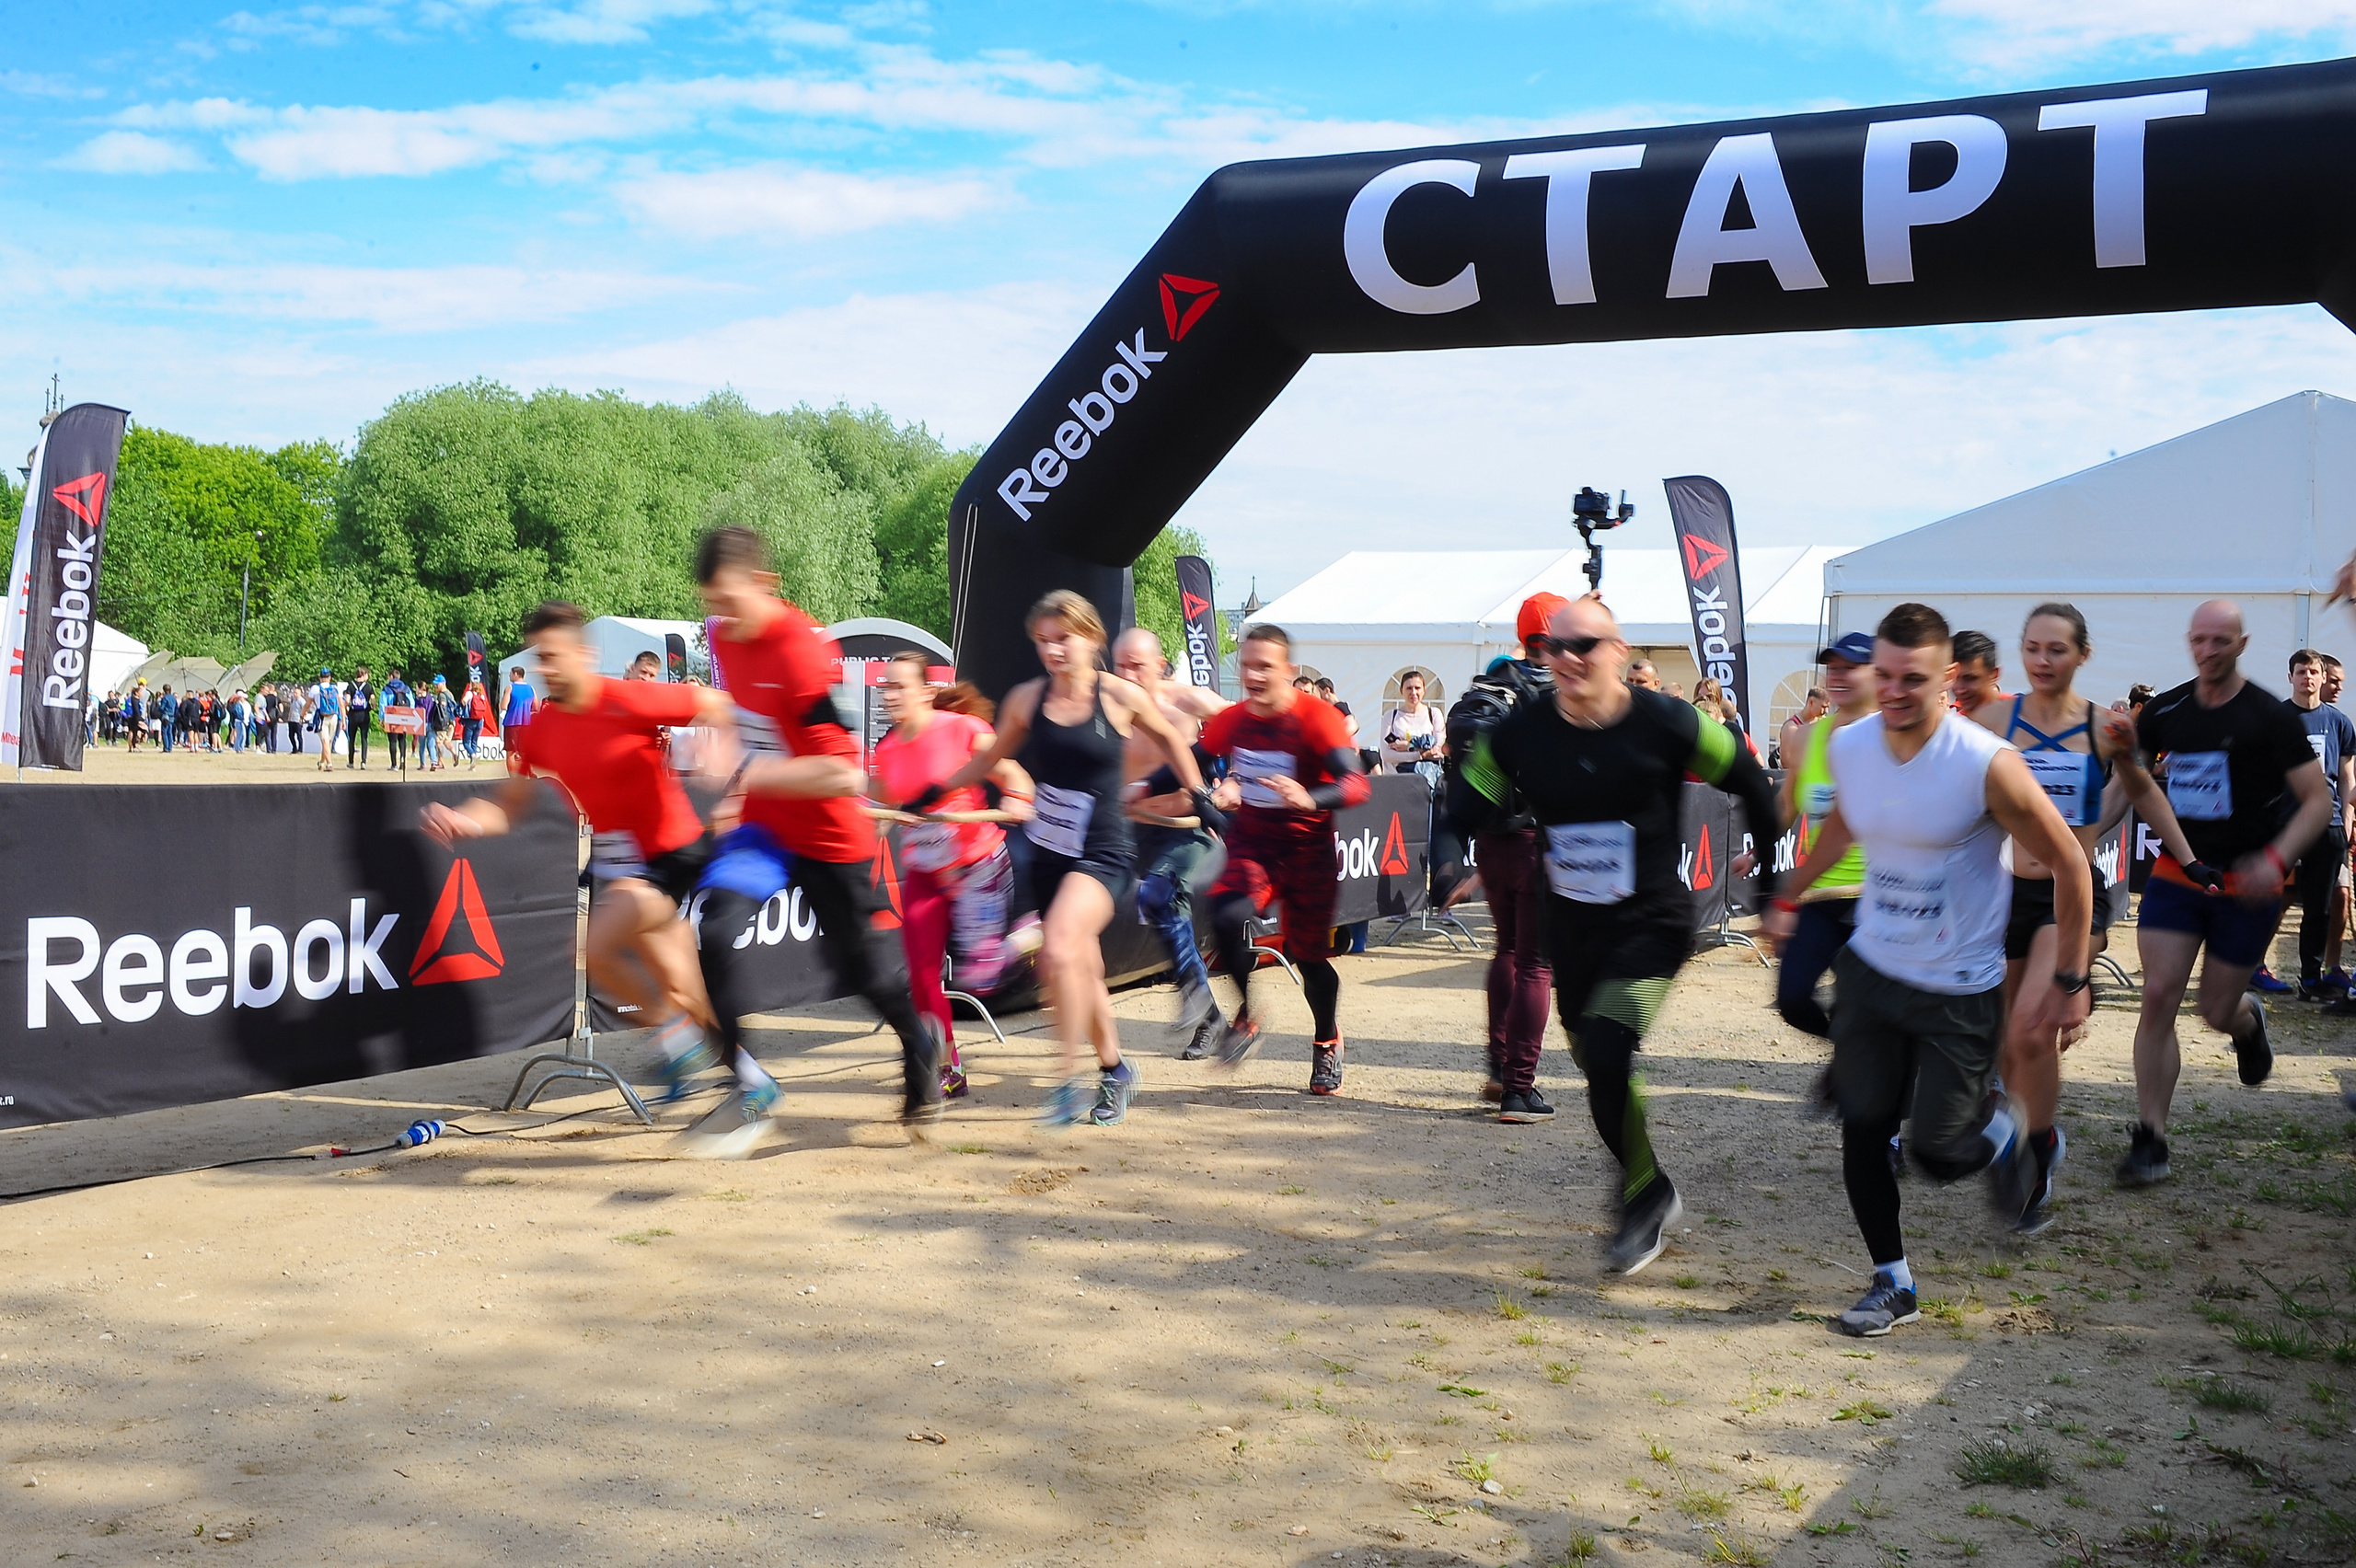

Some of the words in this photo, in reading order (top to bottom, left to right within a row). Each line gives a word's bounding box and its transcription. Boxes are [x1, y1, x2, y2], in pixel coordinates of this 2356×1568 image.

[1343, 89, 2209, 315] СТАРТ
[997, 327, 1168, 522] Reebok
[42, 531, 97, 709] Reebok
[1186, 623, 1213, 689] ebok
[1692, 584, 1744, 732] ebok
[458, 743, 505, 759] Rebok
[1334, 828, 1380, 882] bok
[27, 898, 399, 1030] Reebok
